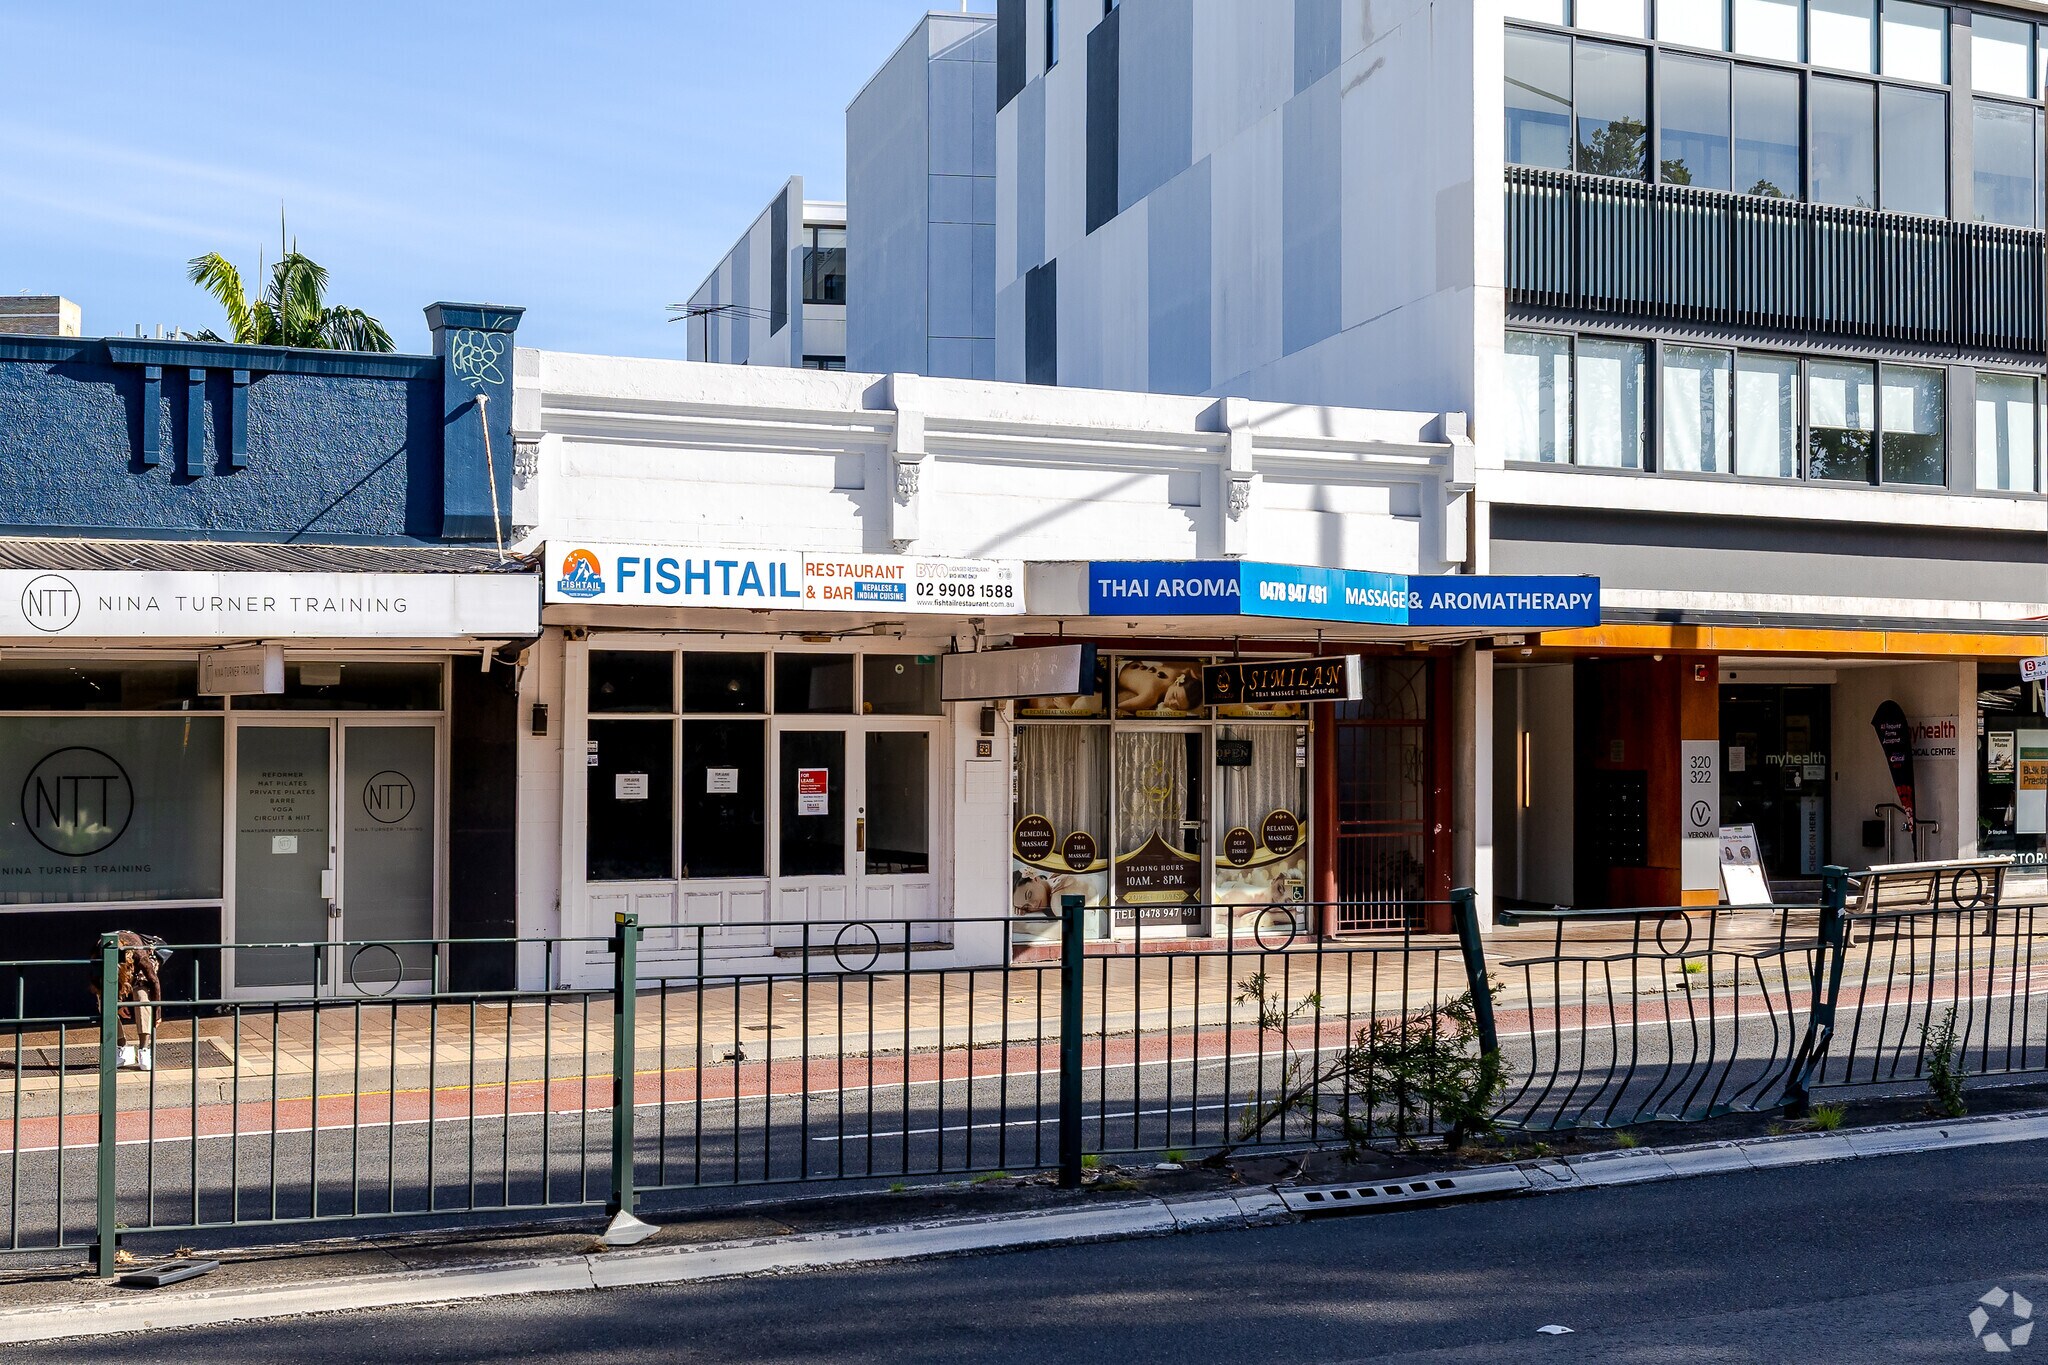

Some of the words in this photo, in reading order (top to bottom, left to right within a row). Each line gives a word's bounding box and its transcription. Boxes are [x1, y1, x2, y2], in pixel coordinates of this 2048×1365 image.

[617, 556, 801, 597] FISHTAIL
[805, 562, 905, 579] RESTAURANT
[916, 563, 949, 578] BYO
[561, 581, 601, 590] FISHTAIL
[805, 585, 816, 599] &
[823, 586, 853, 600] BAR
[862, 583, 893, 592] NEPALESE
[916, 582, 934, 596] 02
[938, 583, 975, 597] 9908
[980, 585, 1013, 598] 1588
[1098, 579, 1149, 597] THAI
[1155, 578, 1241, 597] AROMA
[1259, 580, 1287, 601] 0478
[1287, 583, 1307, 603] 947
[1308, 584, 1328, 604] 491
[29, 589, 73, 617] NTT
[857, 591, 878, 600] INDIAN
[879, 592, 904, 601] CUISINE
[916, 599, 1015, 608] www.fishtailrestaurant.com.au
[1345, 587, 1406, 609] MASSAGE
[1408, 591, 1424, 609] &
[1429, 592, 1593, 610] AROMATHERAPY
[99, 596, 160, 611] NINA
[175, 596, 276, 612] TURNER
[290, 597, 407, 613] TRAINING
[1249, 665, 1343, 690] SIMILAN
[1908, 721, 1956, 744] yhealth
[1216, 748, 1249, 758] OPEN
[1930, 747, 1956, 756] CENTRE
[1690, 755, 1712, 769] 320
[1765, 752, 1827, 767] myhealth
[1690, 770, 1712, 784] 322
[36, 775, 119, 828] NTT
[369, 784, 409, 810] NTT
[1808, 811, 1817, 832] HERE
[1020, 830, 1051, 838] REMEDIAL
[1687, 831, 1715, 839] VERONA
[2, 867, 32, 875] NINA
[39, 866, 88, 875] TURNER
[90, 864, 152, 873] TRAINING
[1126, 875, 1154, 886] 10AM.
[1163, 874, 1186, 885] 8PM.
[1139, 908, 1161, 918] 0478
[1163, 908, 1179, 917] 947
[1182, 907, 1196, 917] 491
